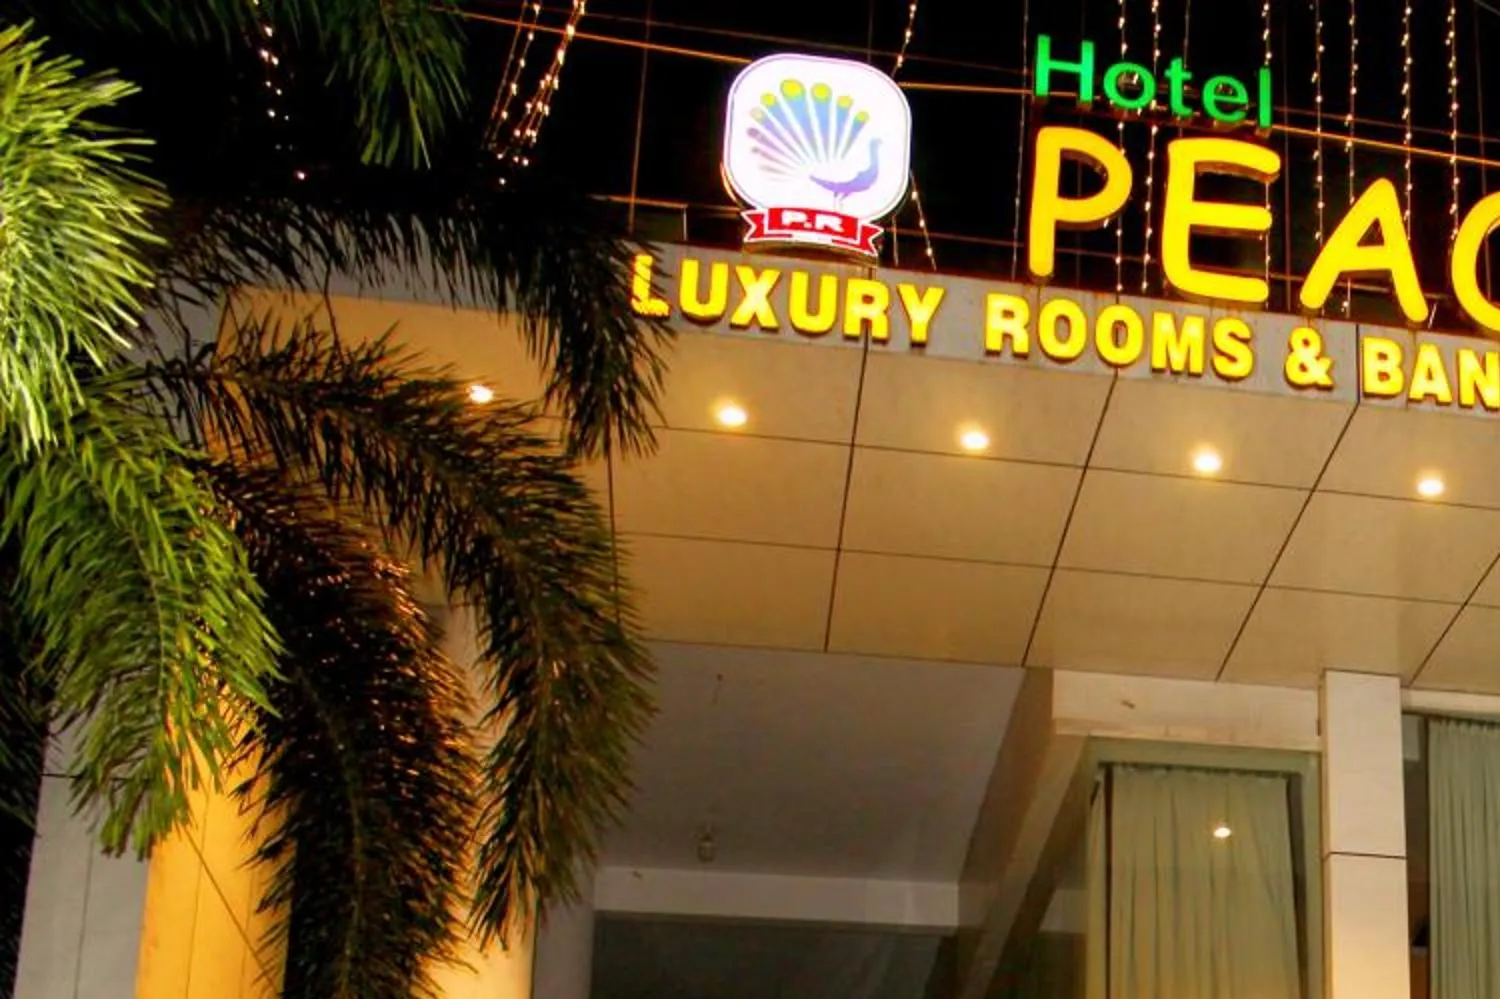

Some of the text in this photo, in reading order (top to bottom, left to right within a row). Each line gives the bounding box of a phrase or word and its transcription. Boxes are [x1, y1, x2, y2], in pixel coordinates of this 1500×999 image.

[1034, 34, 1273, 129] Hotel
[631, 254, 945, 345] LUXURY
[984, 292, 1254, 380] ROOMS
[1284, 327, 1333, 388] &
